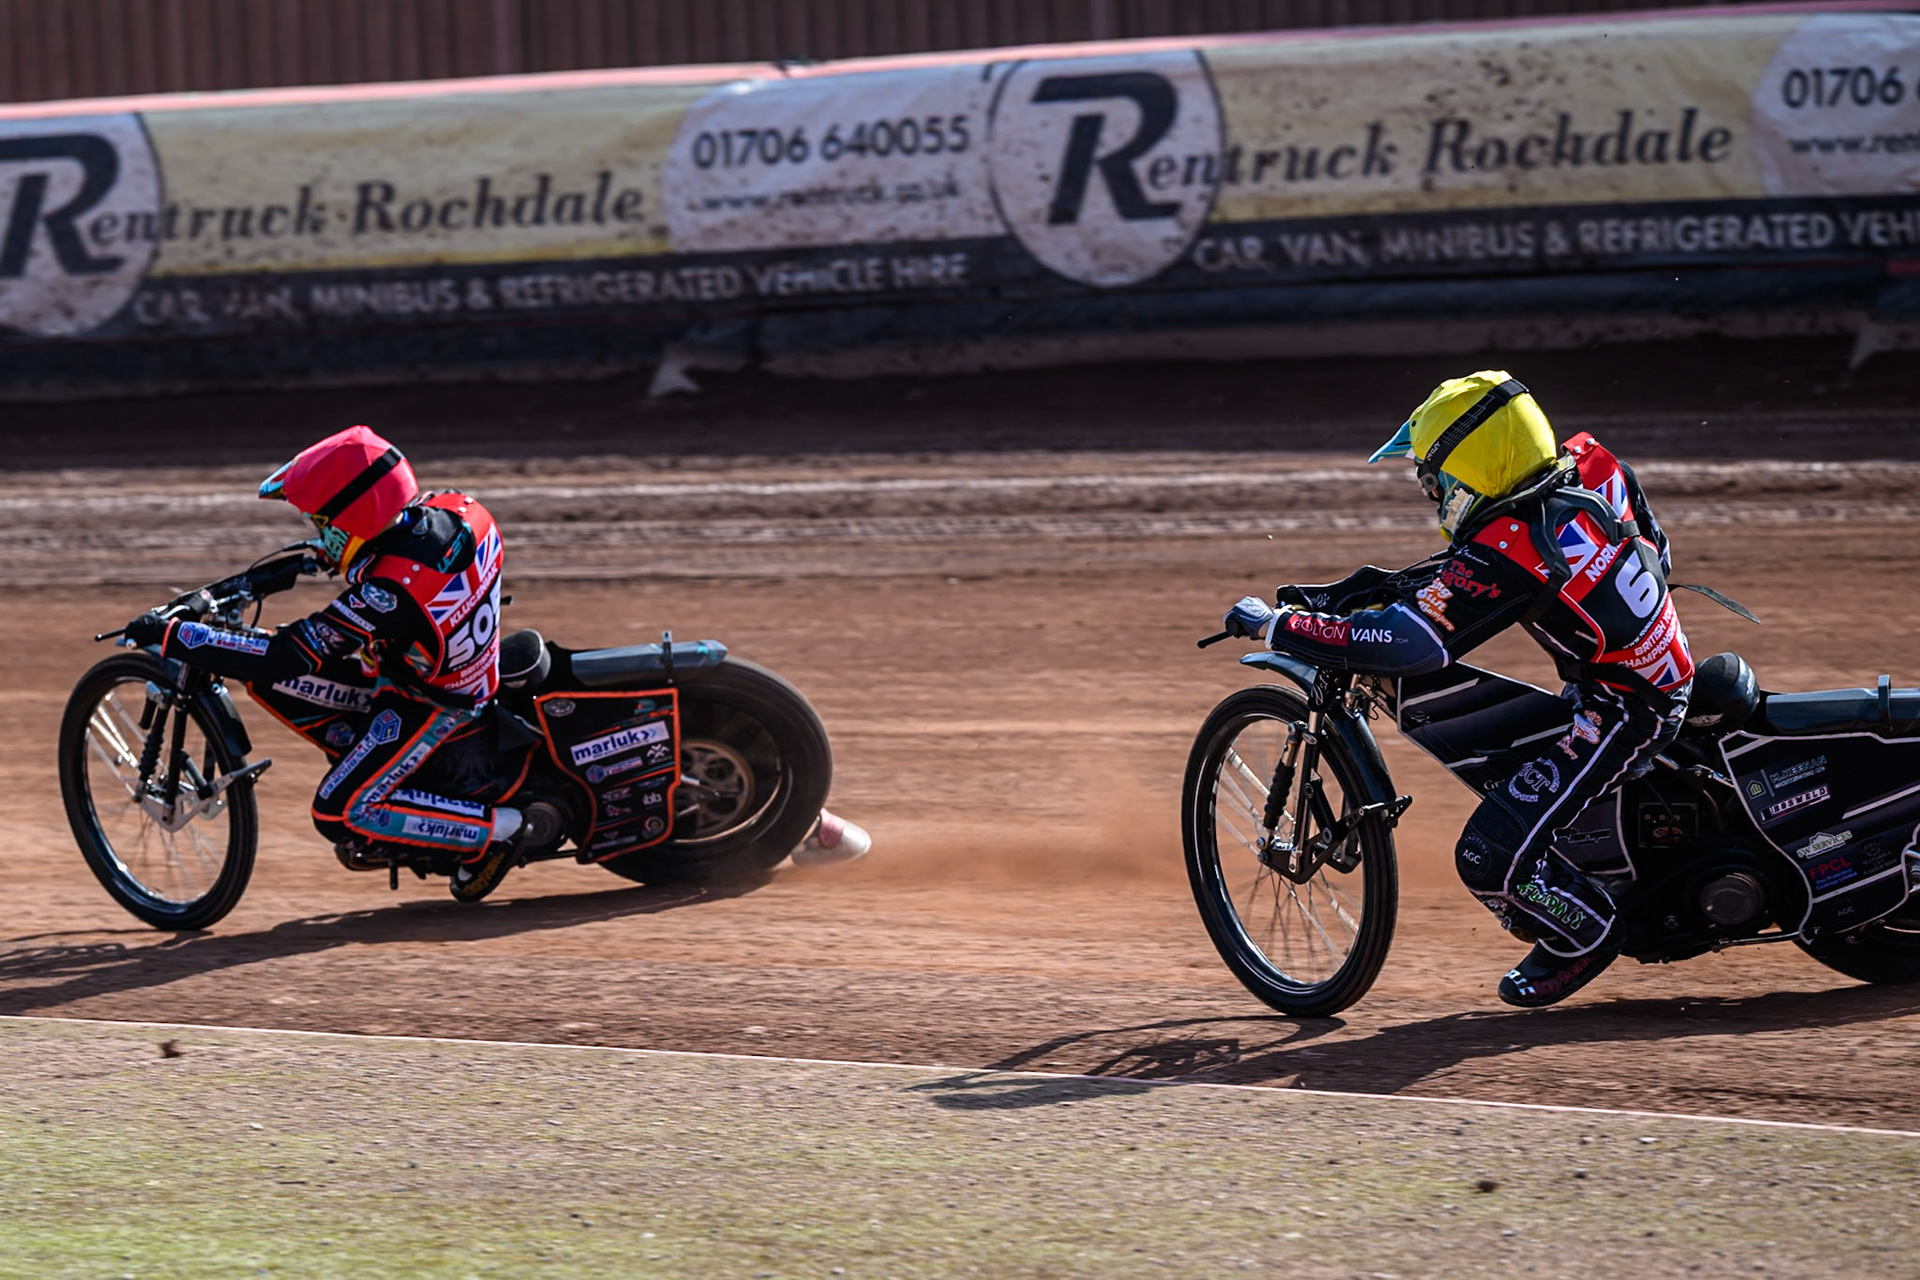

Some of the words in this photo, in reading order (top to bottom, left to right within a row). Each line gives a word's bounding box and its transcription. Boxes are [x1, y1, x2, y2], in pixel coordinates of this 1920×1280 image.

[1783, 66, 1904, 109] 01706
[692, 125, 809, 170] 01706
[822, 115, 971, 162] 640055
[1423, 107, 1732, 175] Rochdale
[352, 171, 643, 235] Rochdale
[1380, 221, 1535, 263] MINIBUS
[1543, 220, 1569, 254] &
[1578, 211, 1836, 253] REFRIGERATED
[465, 276, 494, 310] &
[496, 265, 742, 309] REFRIGERATED
[746, 257, 882, 297] VEHICLE
[889, 252, 968, 289] HIRE
[1449, 559, 1475, 579] The
[1615, 550, 1659, 619] 6
[1415, 588, 1448, 613] Sun
[1290, 616, 1346, 641] BOLTON
[1351, 628, 1393, 644] VANS
[1634, 622, 1666, 657] BRITISH
[574, 730, 639, 761] marluk
[1461, 847, 1483, 866] AGC
[1811, 832, 1853, 851] SERVICES
[1808, 857, 1854, 880] FPCL
